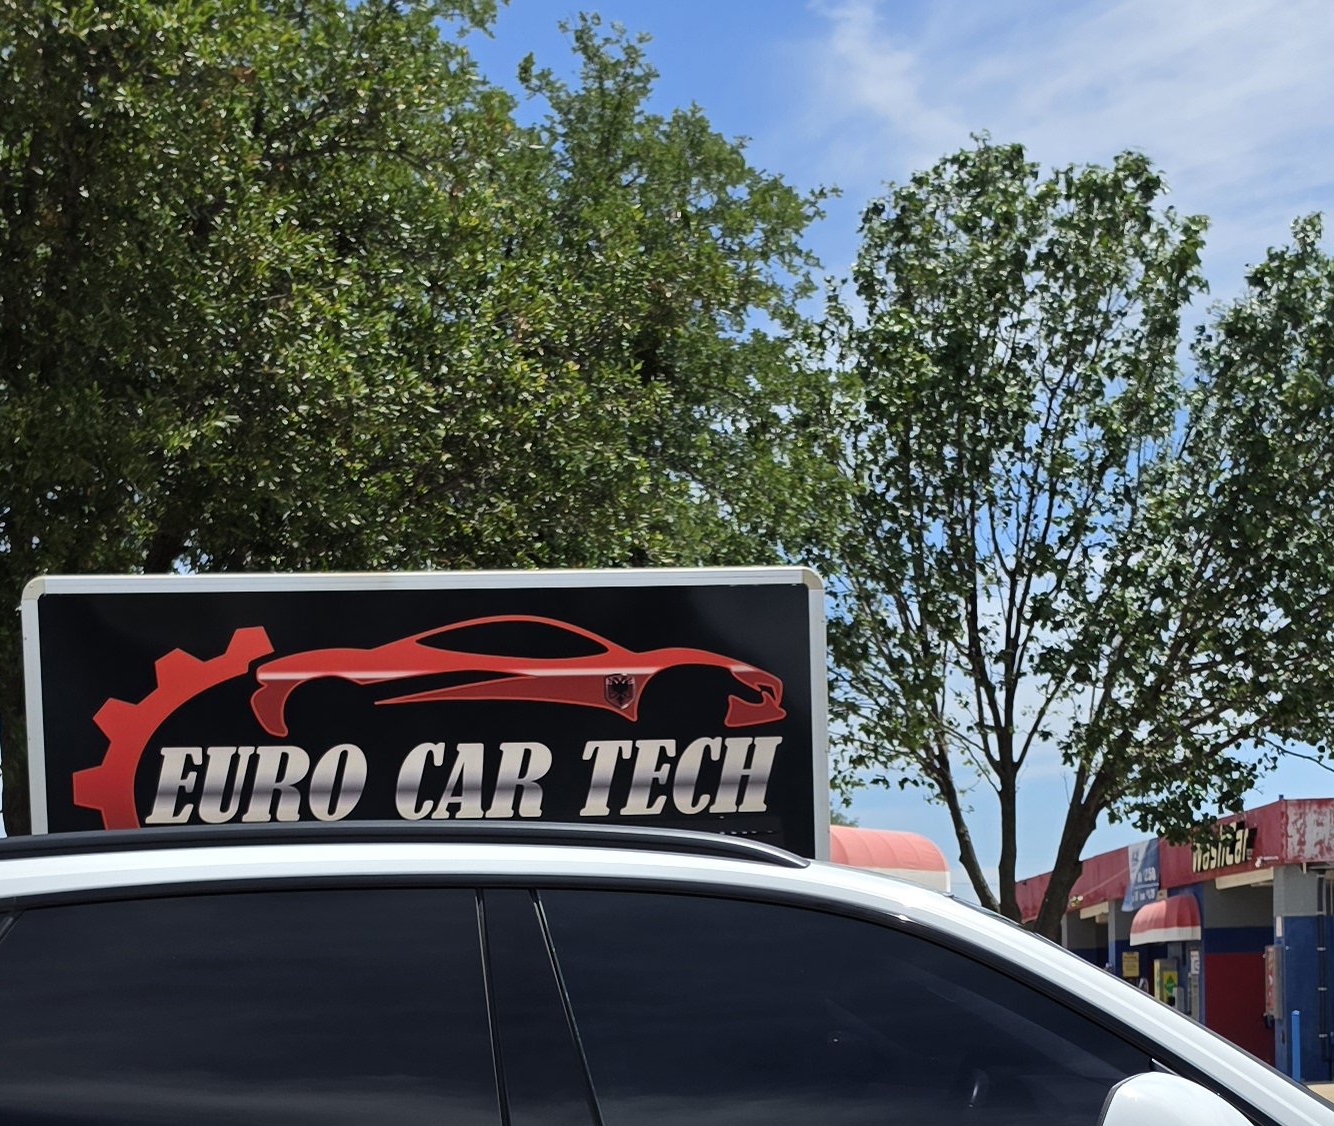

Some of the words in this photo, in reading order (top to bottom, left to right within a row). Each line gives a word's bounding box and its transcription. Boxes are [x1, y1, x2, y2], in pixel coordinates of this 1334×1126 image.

[145, 743, 367, 824] EURO
[395, 741, 553, 820] CAR
[579, 736, 783, 816] TECH
